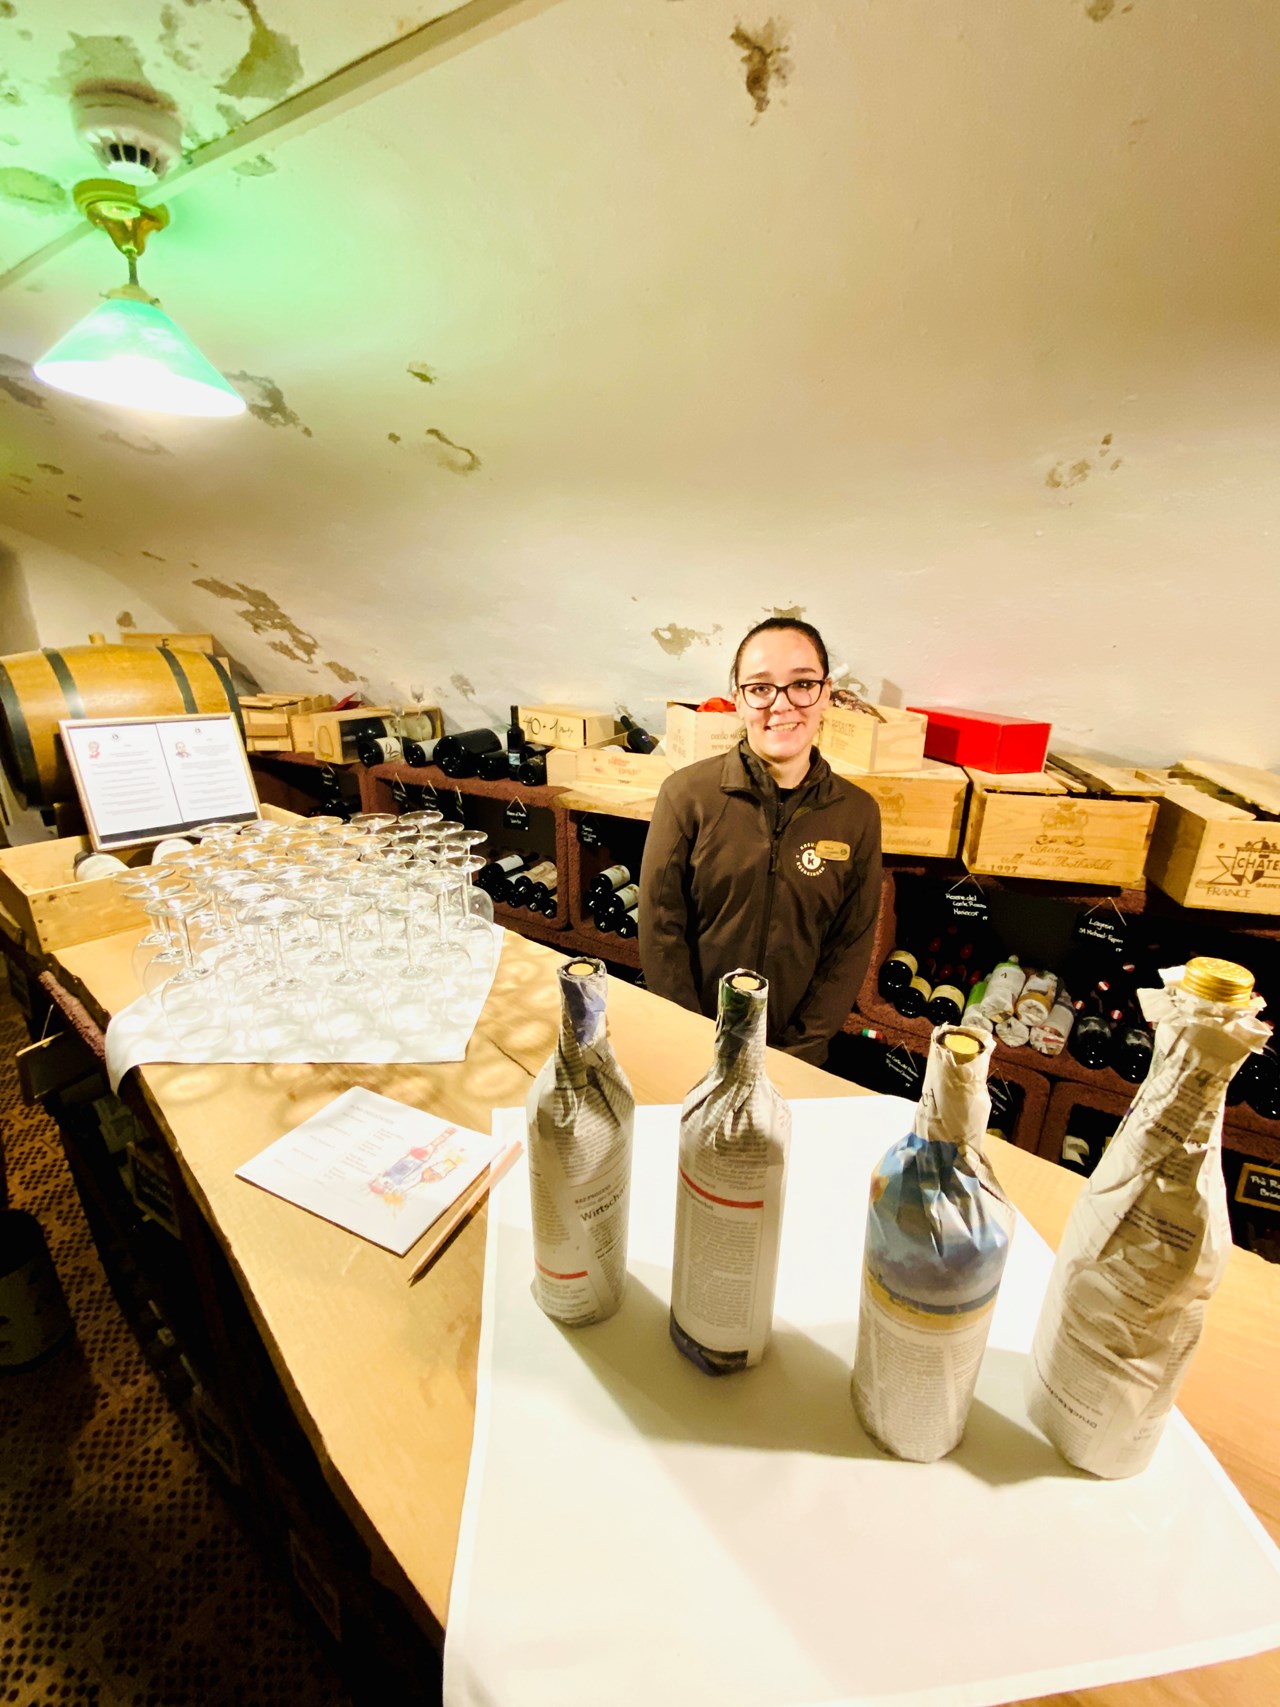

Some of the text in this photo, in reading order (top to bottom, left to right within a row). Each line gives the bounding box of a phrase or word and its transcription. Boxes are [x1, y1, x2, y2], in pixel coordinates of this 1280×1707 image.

[522, 715, 542, 736] 40
[990, 864, 1019, 873] 1997
[1206, 886, 1251, 898] FRANCE
